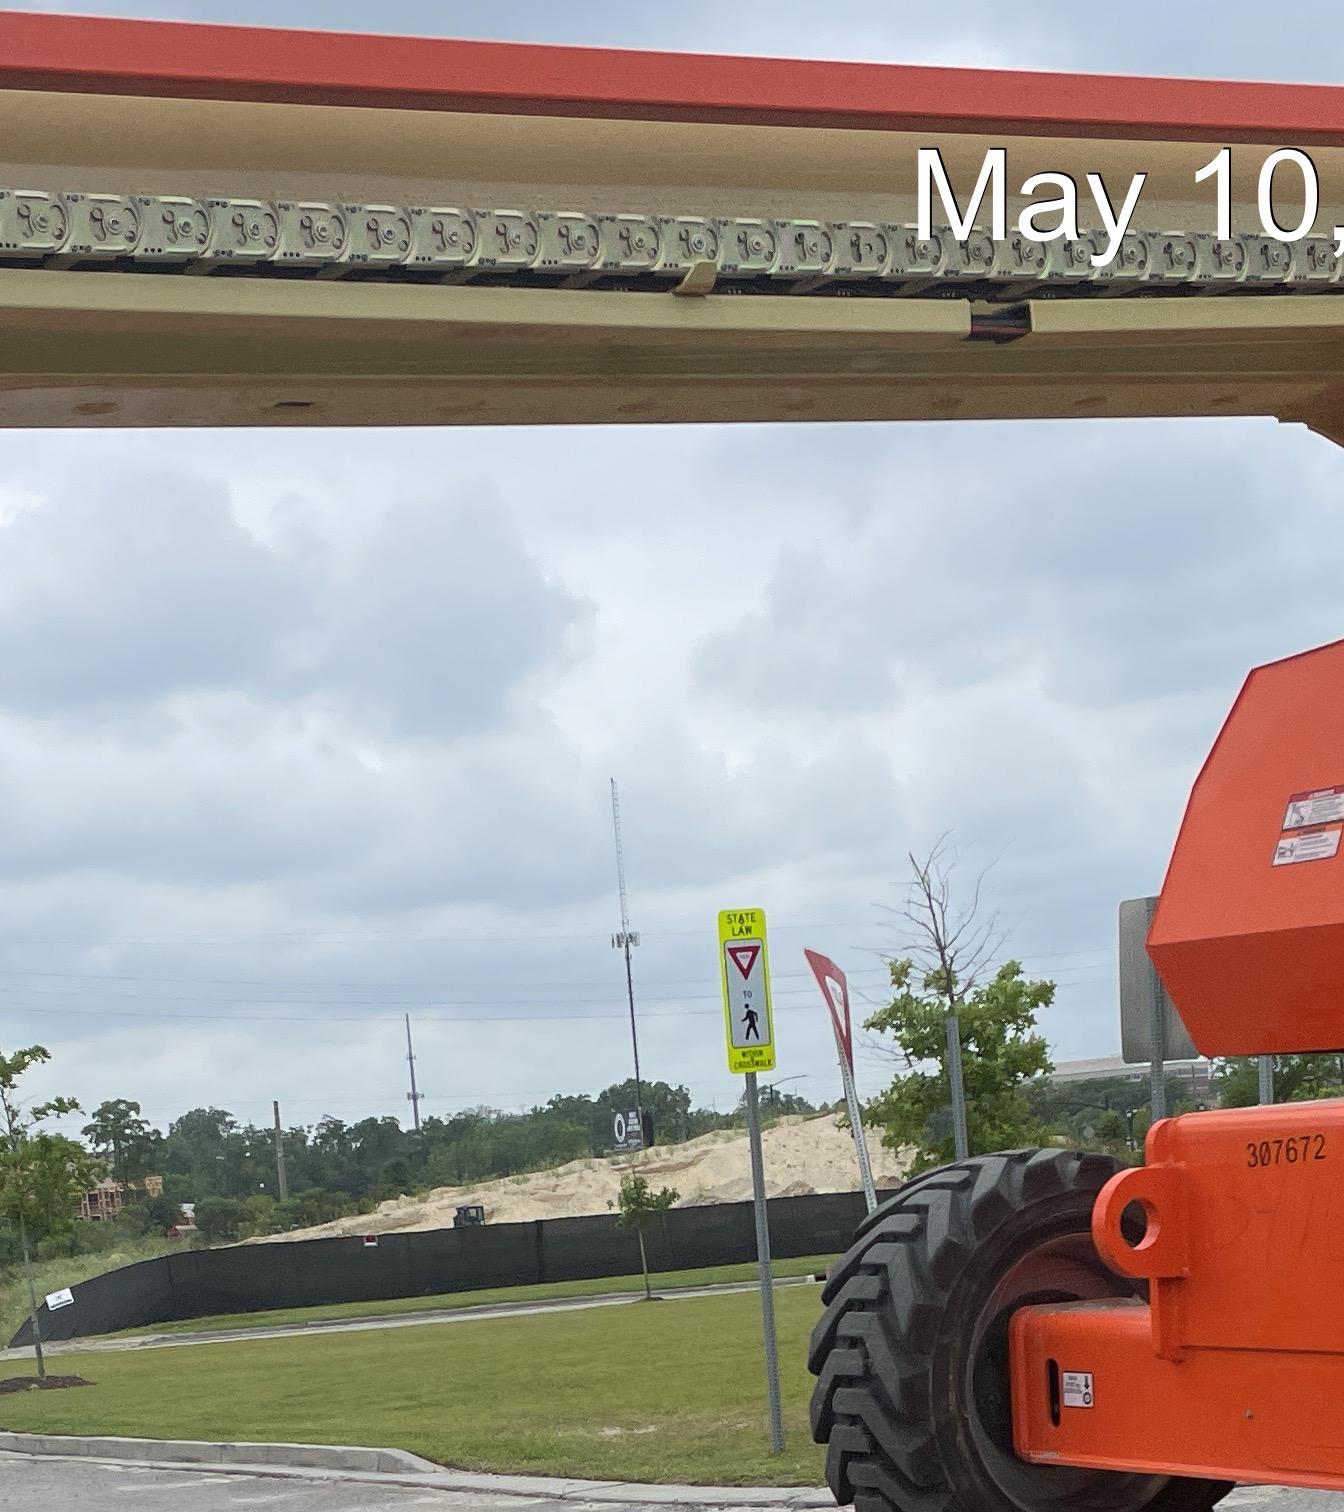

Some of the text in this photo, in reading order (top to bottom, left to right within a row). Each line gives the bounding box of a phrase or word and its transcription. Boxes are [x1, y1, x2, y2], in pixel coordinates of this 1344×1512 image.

[726, 911, 757, 925] STATE
[731, 925, 753, 937] LAW
[742, 989, 753, 999] TO
[1246, 1133, 1328, 1168] 307672
